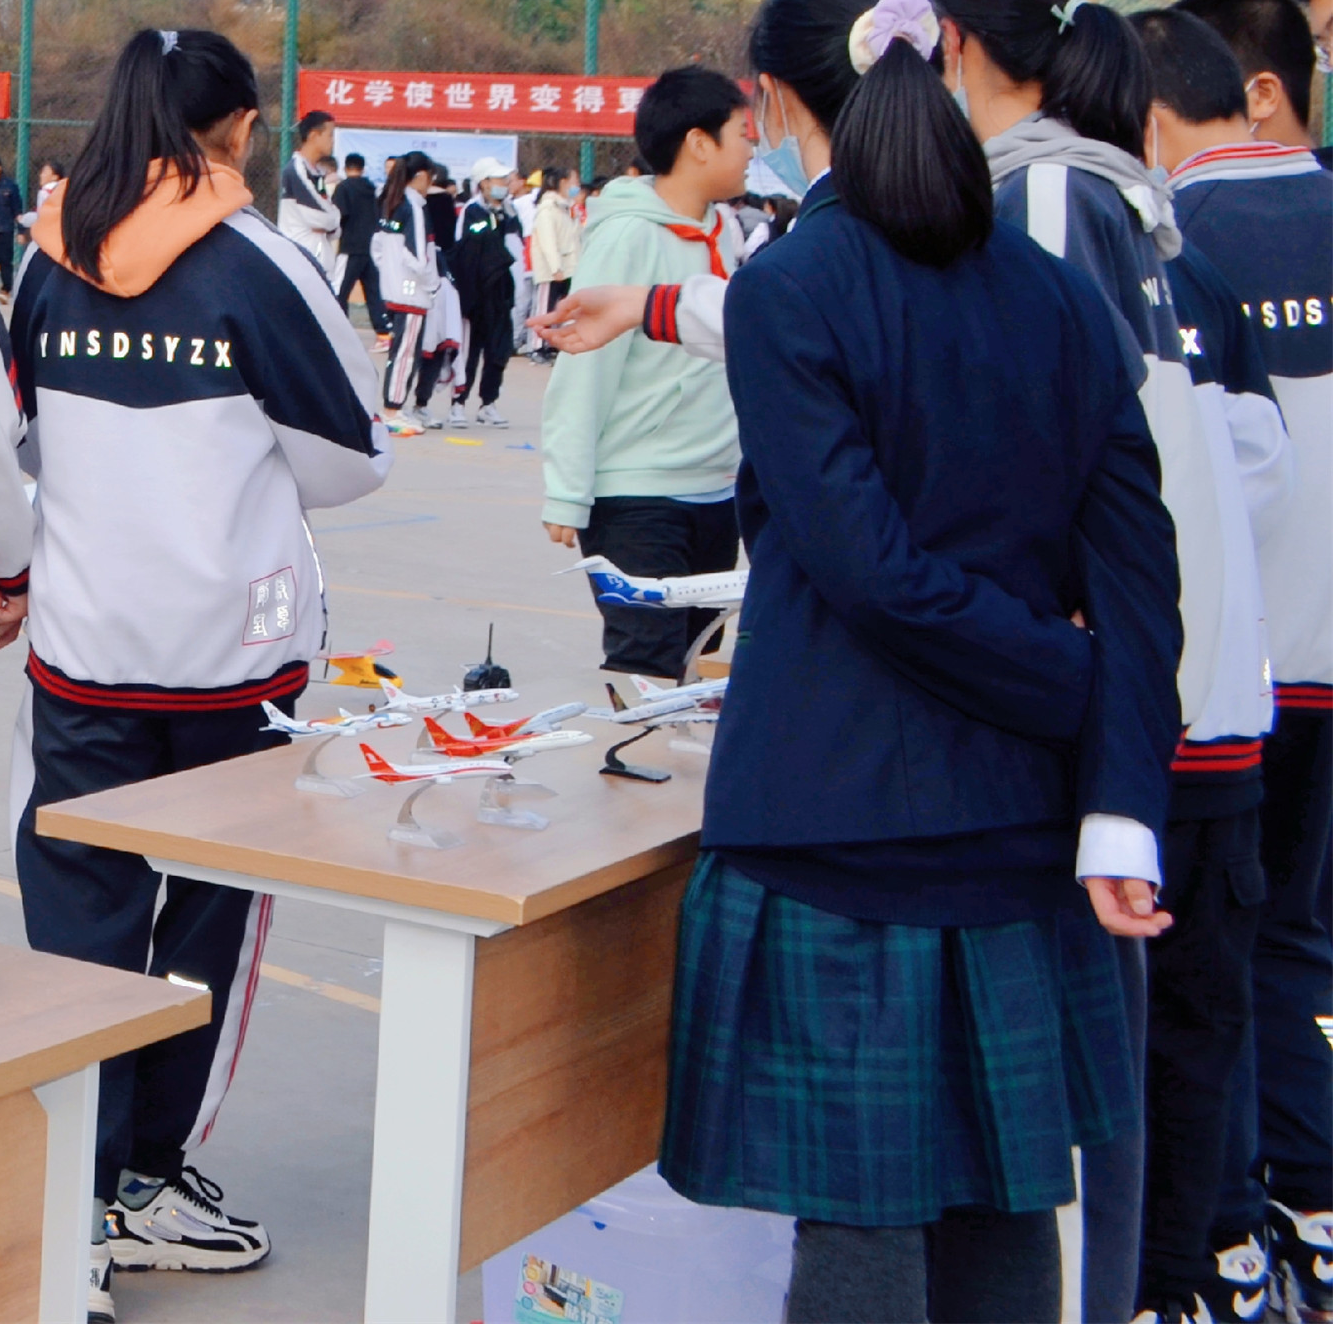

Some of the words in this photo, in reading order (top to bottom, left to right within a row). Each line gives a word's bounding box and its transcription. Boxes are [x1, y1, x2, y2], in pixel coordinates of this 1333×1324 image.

[325, 78, 645, 114] 化学使世界变得更
[1241, 297, 1333, 329] SDS
[39, 330, 233, 368] YNSDSYZX
